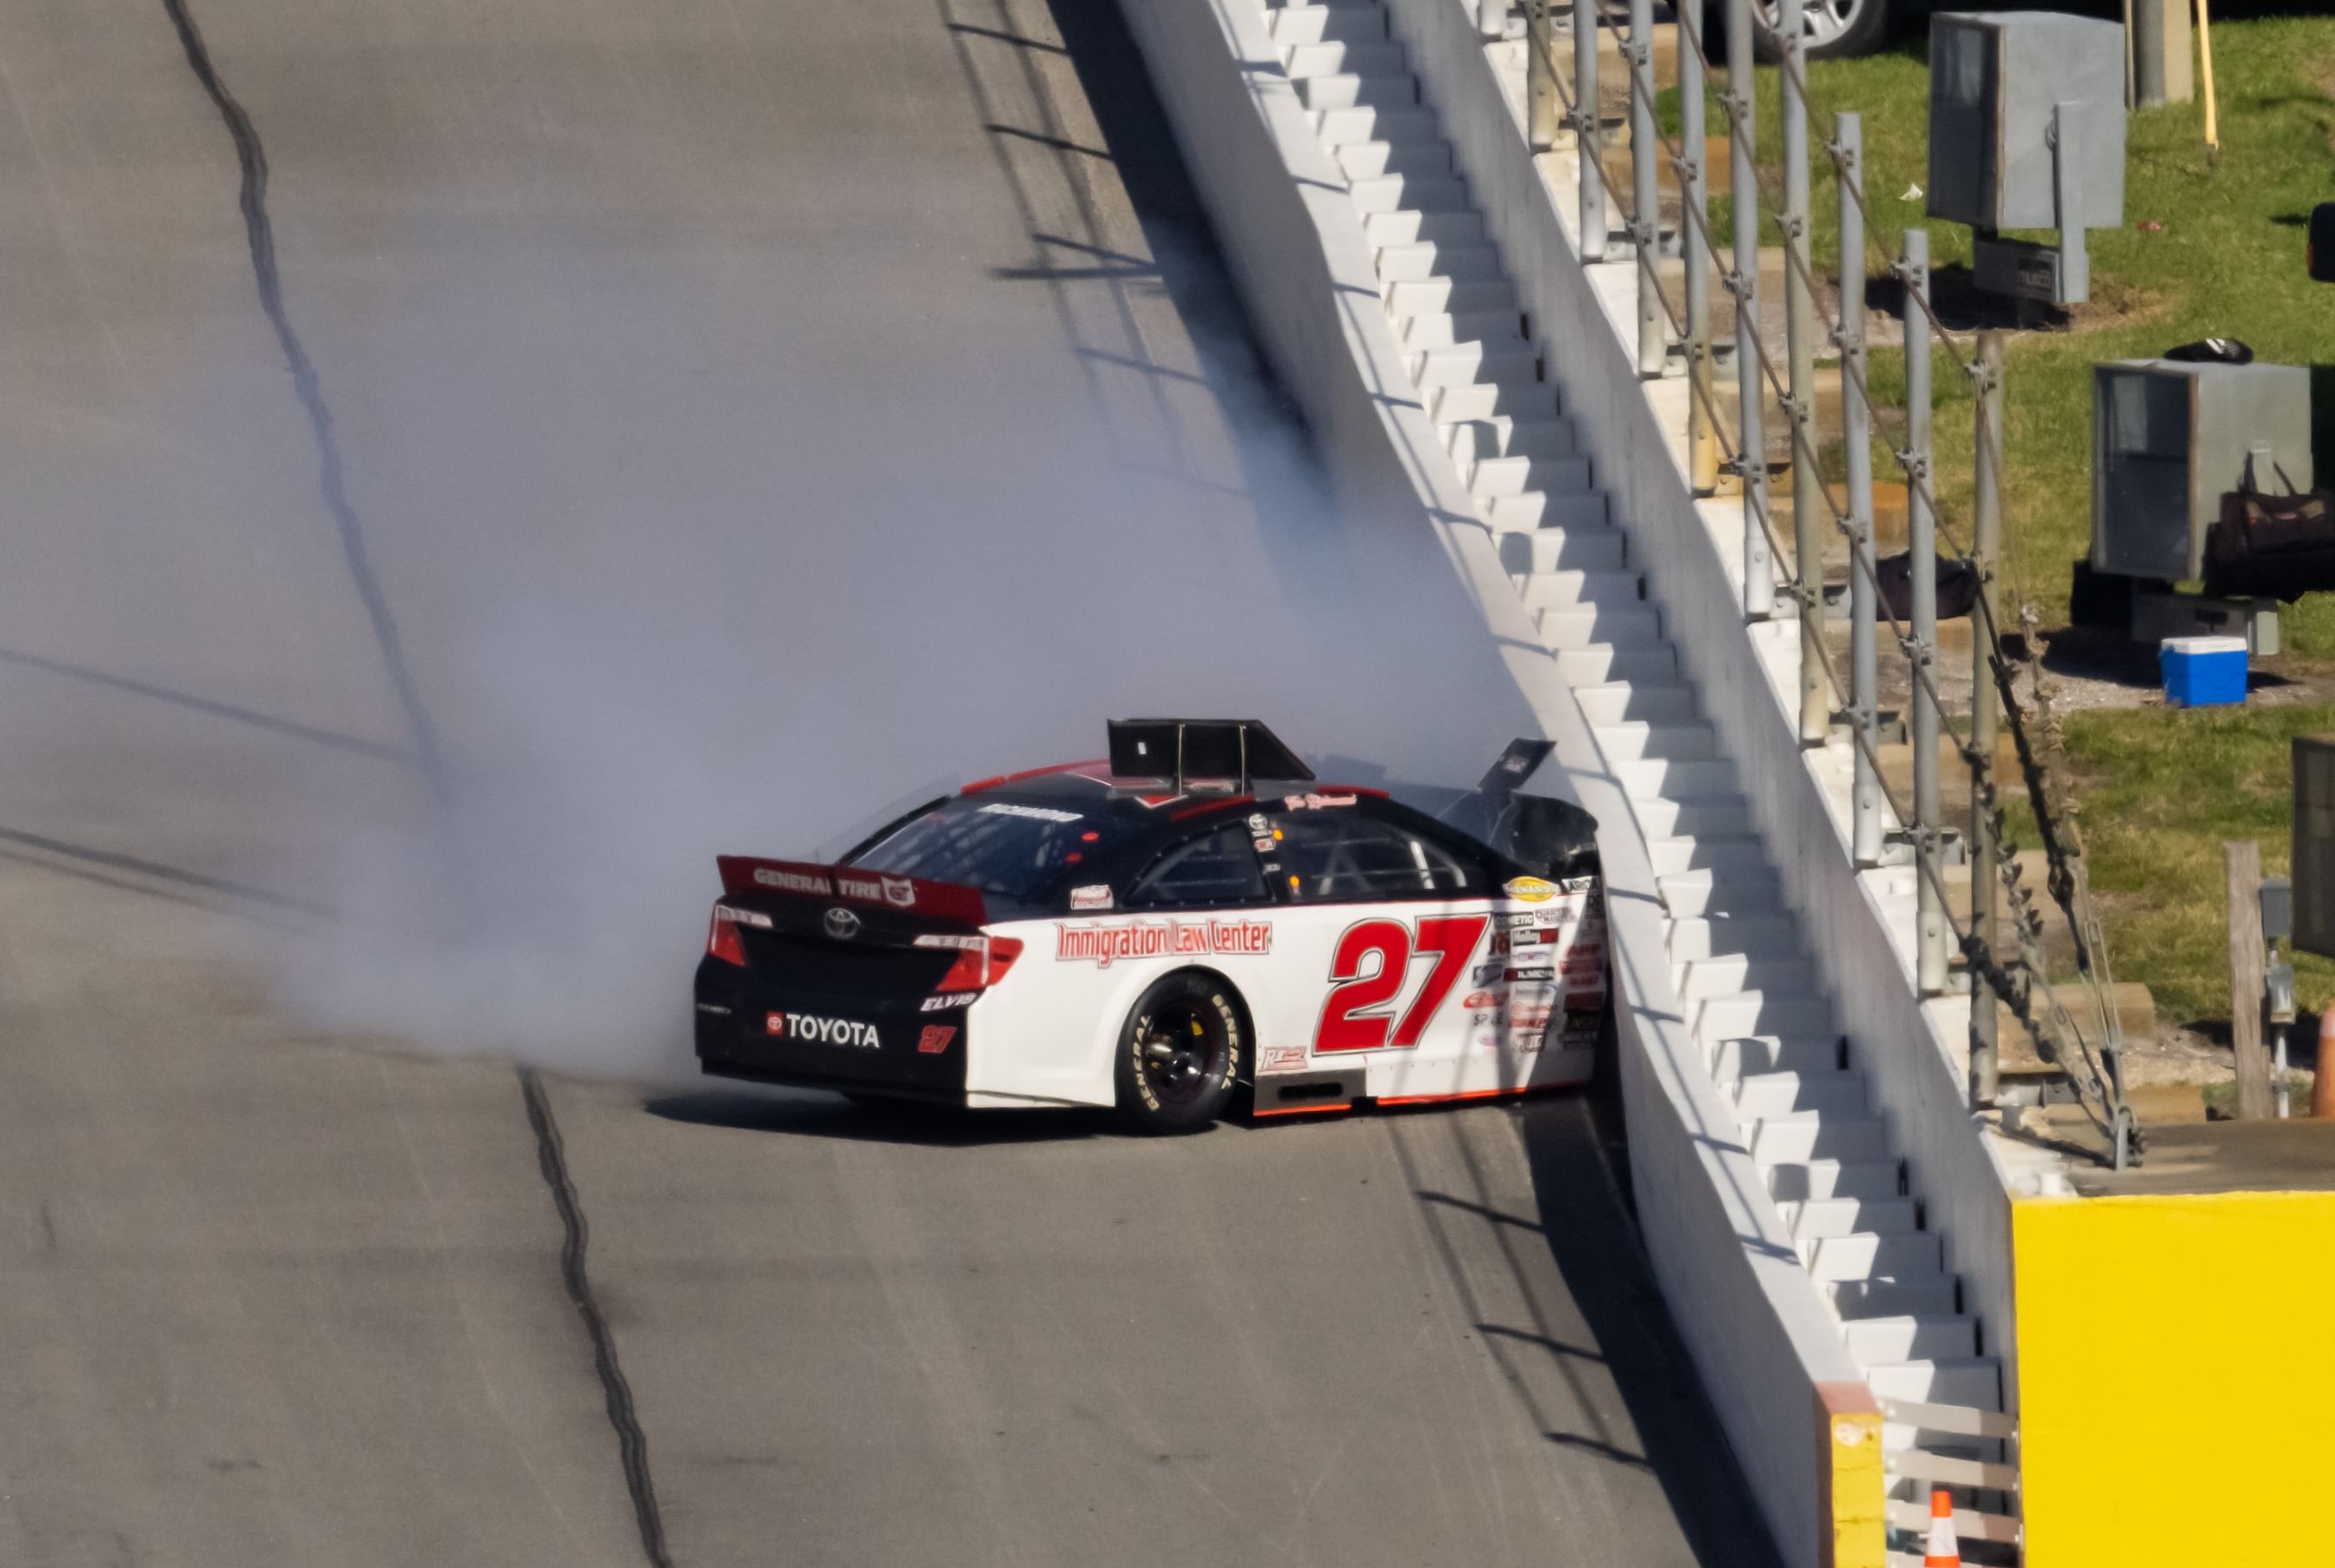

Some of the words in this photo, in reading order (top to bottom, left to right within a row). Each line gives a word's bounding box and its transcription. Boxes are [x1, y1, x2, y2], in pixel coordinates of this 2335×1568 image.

[838, 878, 882, 902] TIRE
[1057, 923, 1169, 966] Immigration
[1171, 919, 1208, 954] Law
[1208, 918, 1270, 954] Center
[1312, 911, 1492, 1057] 27
[919, 992, 977, 1013] ELVIS
[786, 1013, 881, 1049] TOYOTA
[918, 1025, 957, 1055] 27
